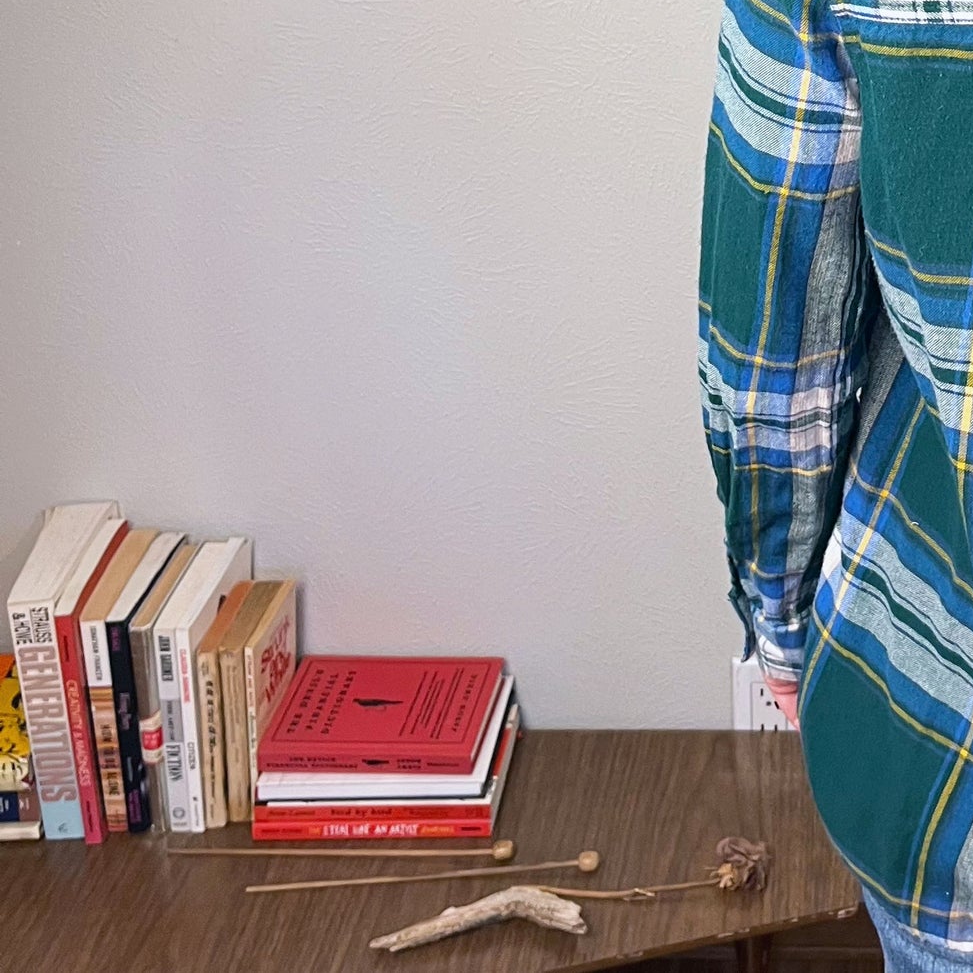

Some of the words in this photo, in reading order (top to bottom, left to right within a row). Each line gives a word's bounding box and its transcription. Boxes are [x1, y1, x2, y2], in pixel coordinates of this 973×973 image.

[12, 612, 25, 621] &
[31, 606, 52, 644] STRAUSS
[18, 645, 78, 803] GENERATIONS
[287, 712, 302, 734] THE
[305, 672, 340, 732] FINANCIAL
[320, 670, 357, 735] DICTIONARY
[66, 680, 84, 730] CREATIVITY
[75, 739, 92, 788] MADNESS
